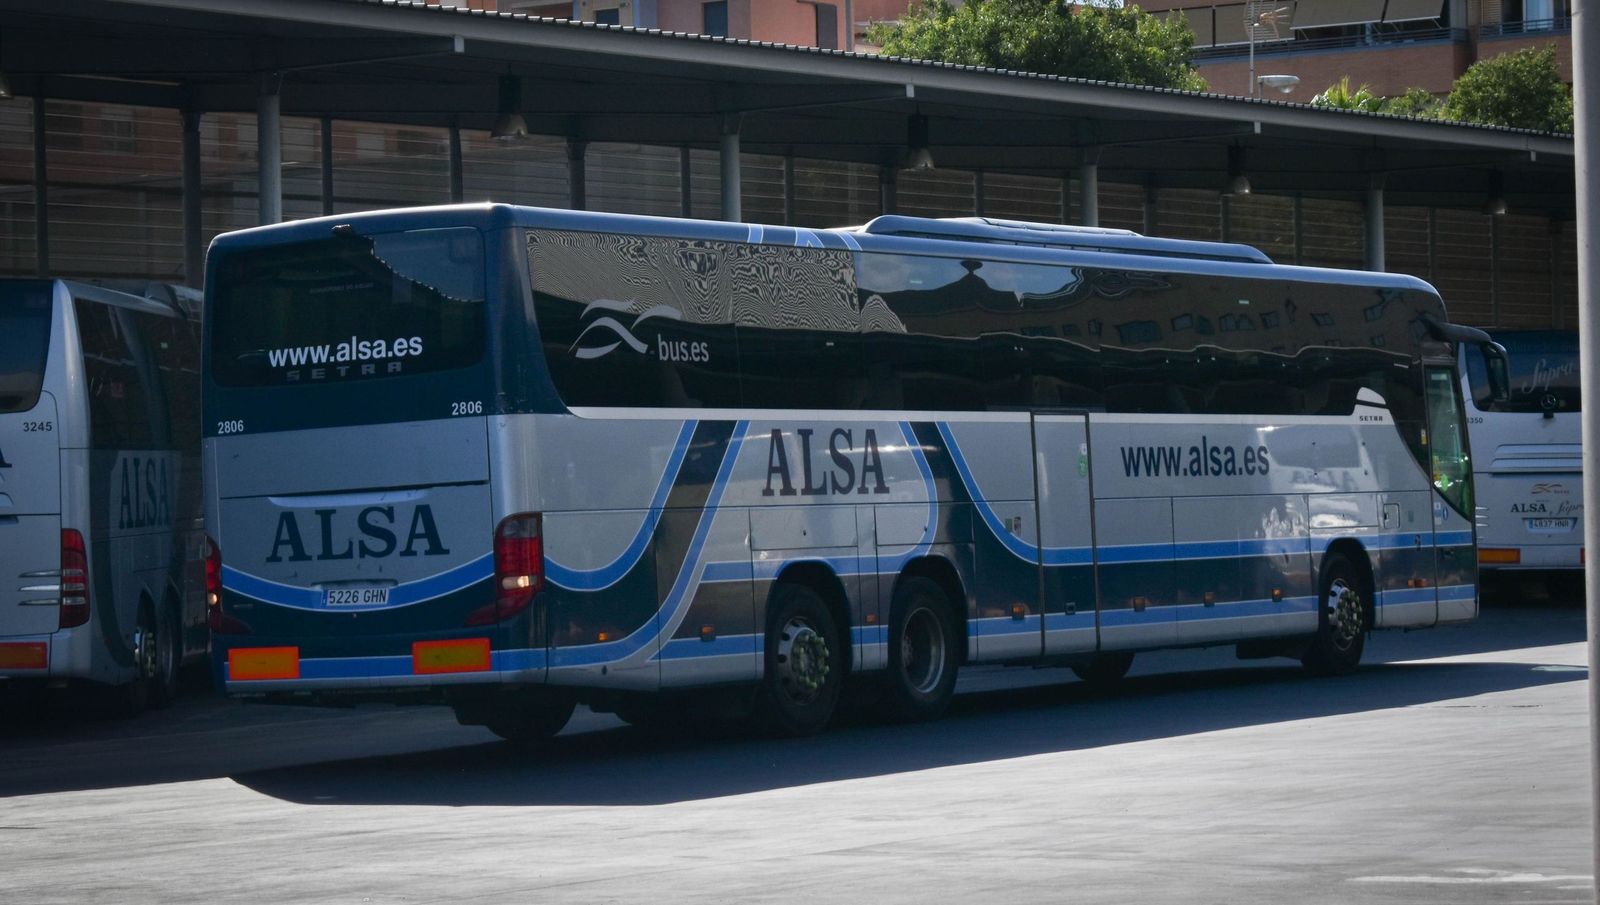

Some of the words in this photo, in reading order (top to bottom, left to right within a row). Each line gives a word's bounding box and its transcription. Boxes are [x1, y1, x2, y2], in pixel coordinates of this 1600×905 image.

[269, 336, 423, 367] www.alsa.es
[658, 333, 710, 362] bus.es
[286, 361, 402, 381] SETRA
[451, 401, 482, 416] 2806
[23, 421, 53, 432] 3245
[217, 419, 244, 434] 2806
[762, 427, 890, 496] ALSA
[1120, 435, 1270, 477] www.alsa.es
[119, 457, 170, 529] ALSA
[1510, 503, 1547, 512] ALSA
[265, 504, 450, 562] ALSA
[329, 589, 358, 604] 5226
[363, 588, 387, 603] GHN
